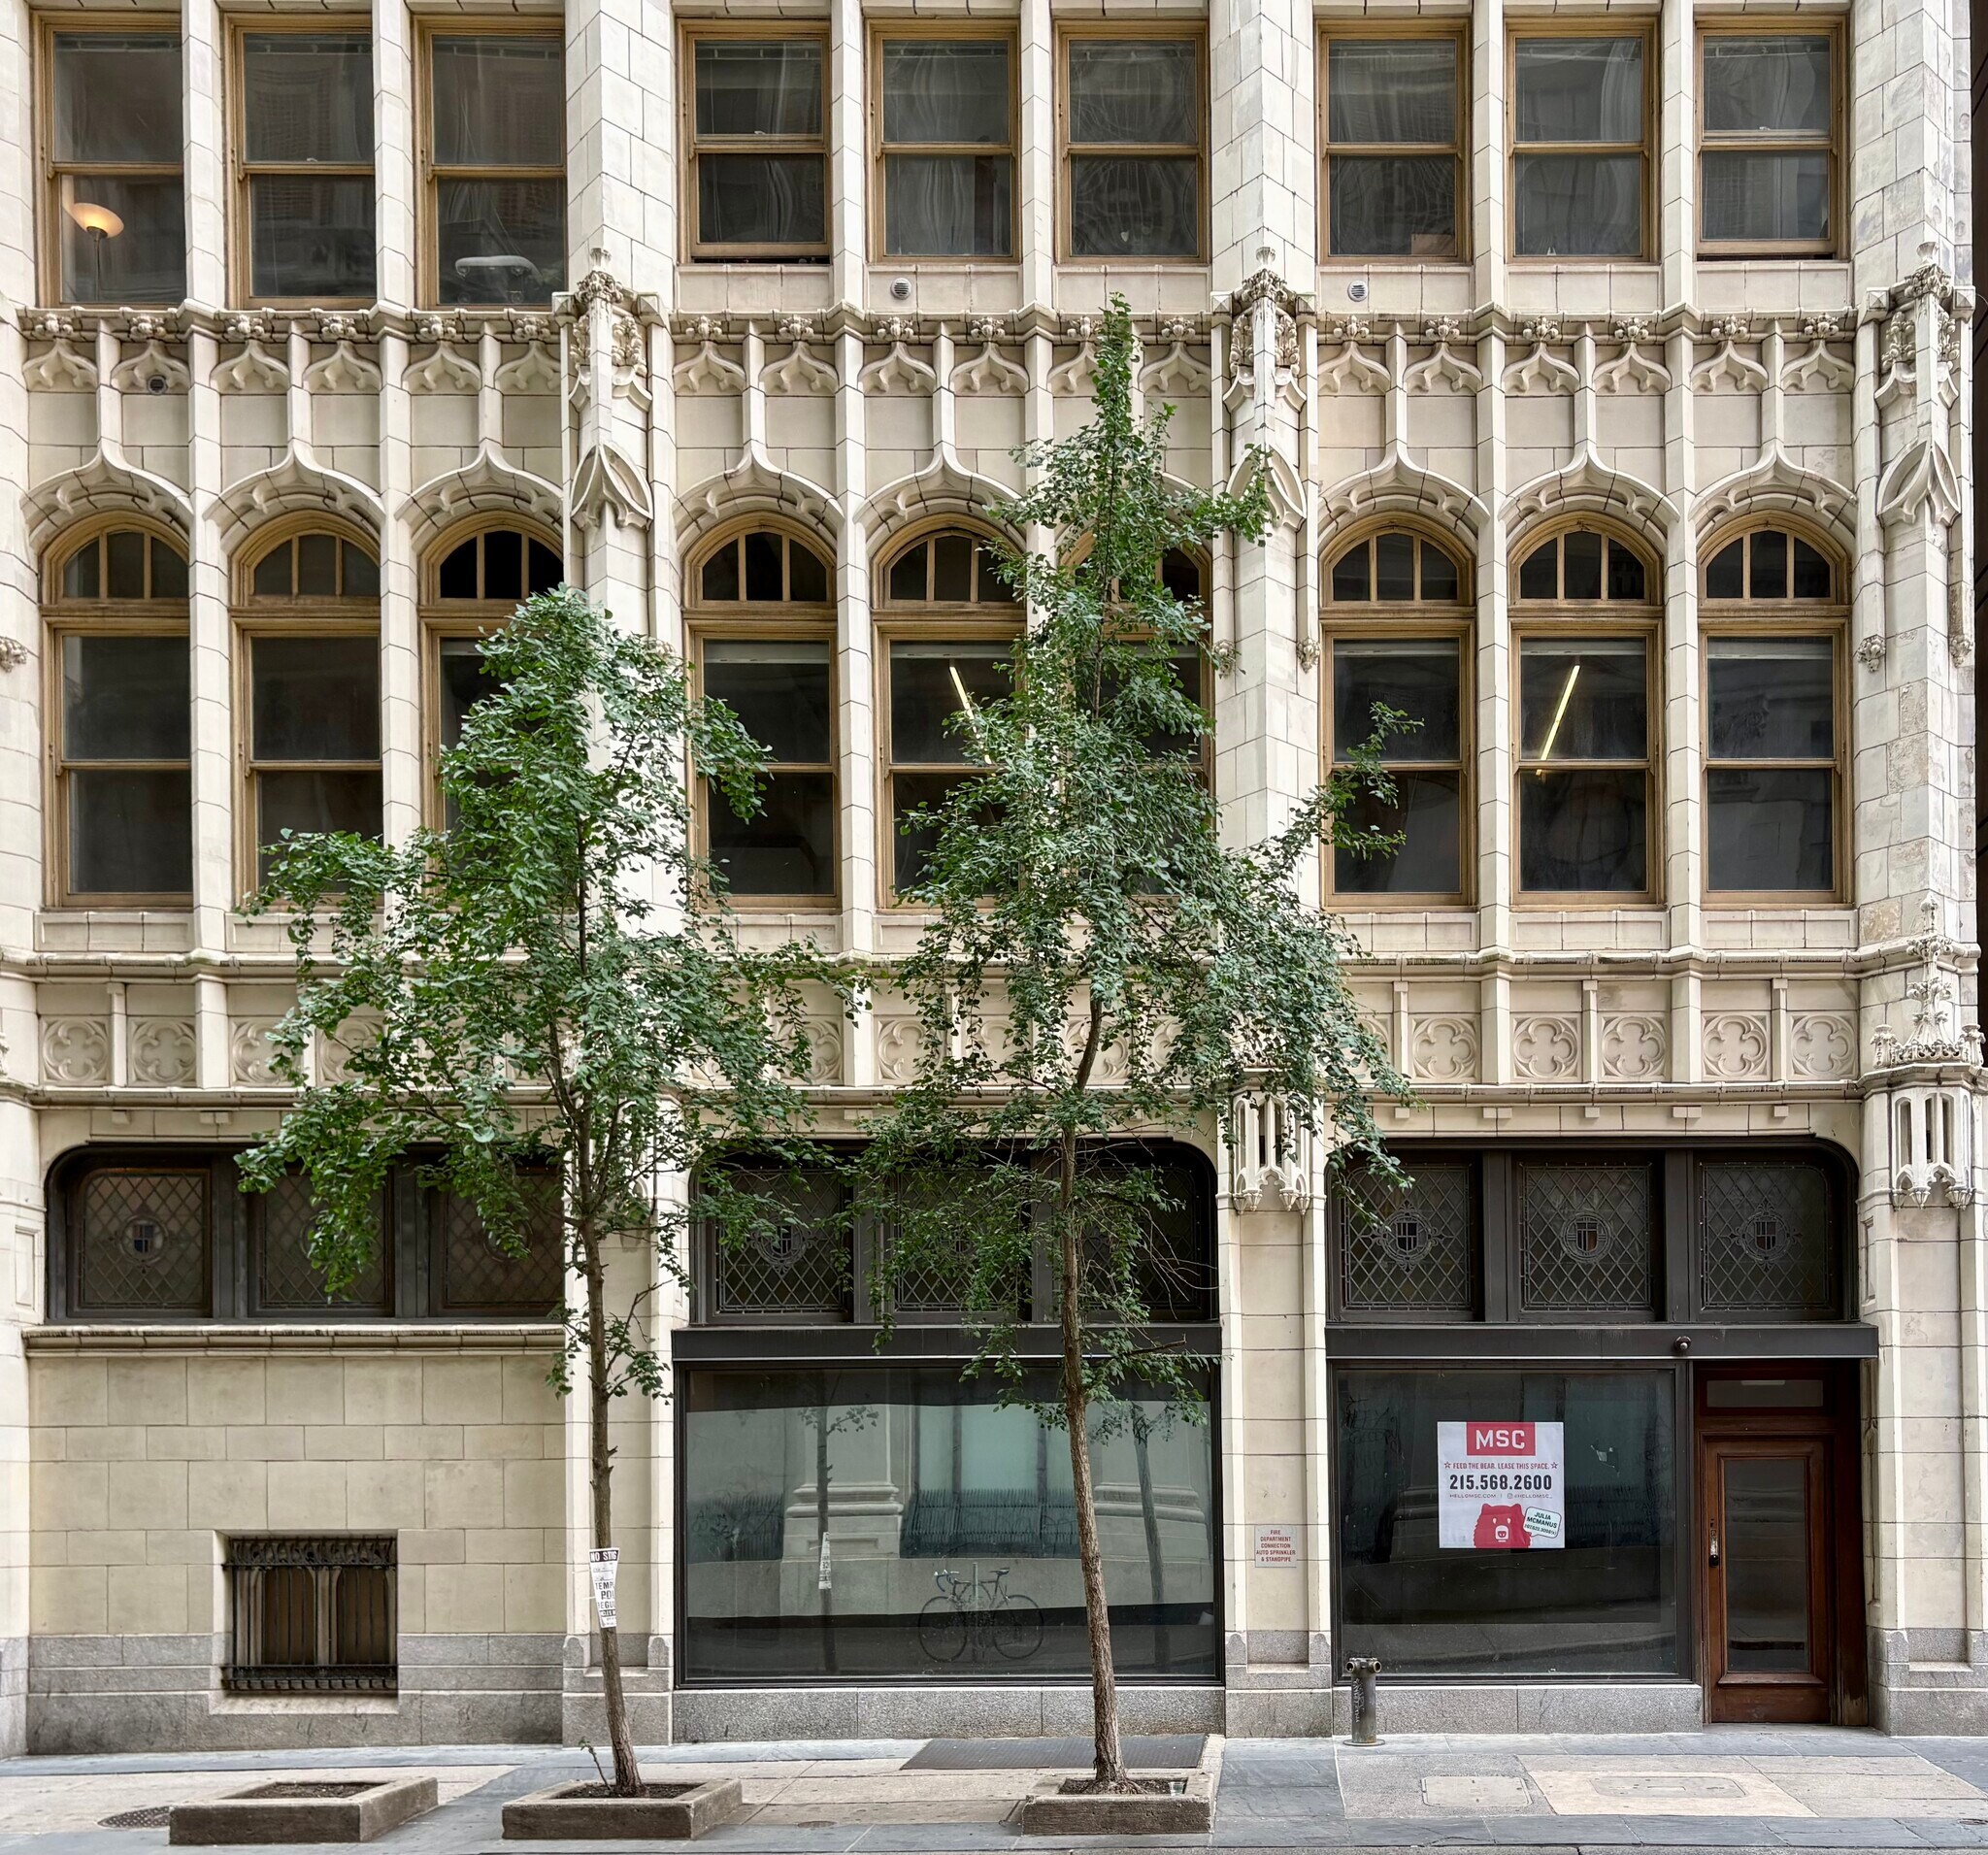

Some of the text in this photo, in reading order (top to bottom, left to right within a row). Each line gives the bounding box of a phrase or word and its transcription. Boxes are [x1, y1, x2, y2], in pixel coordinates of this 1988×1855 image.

[1475, 1429, 1525, 1450] MSC
[1449, 1474, 1552, 1490] 215.568.2600
[1527, 1516, 1558, 1529] MCMANUS
[590, 1551, 601, 1562] NO
